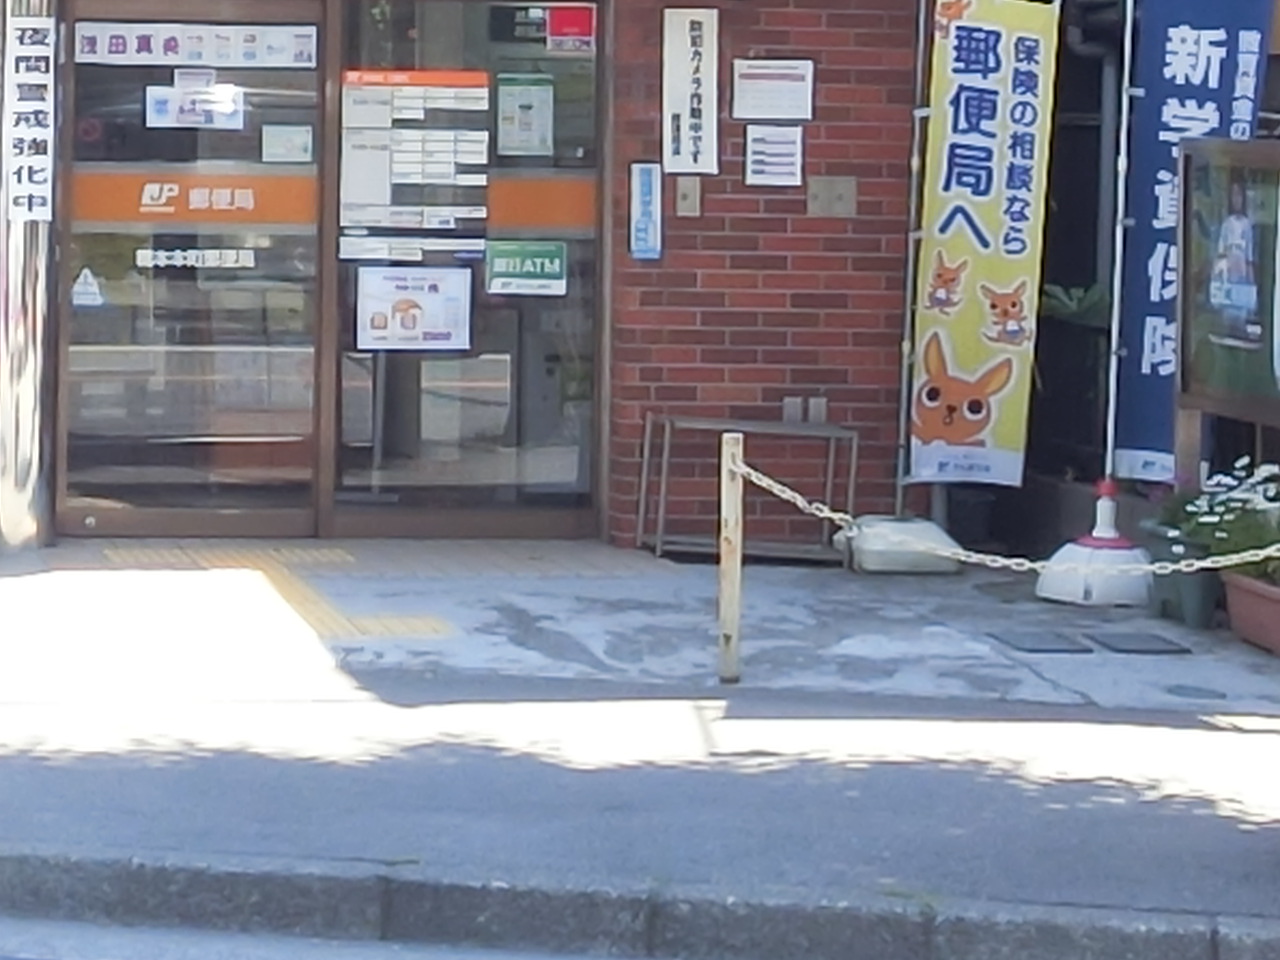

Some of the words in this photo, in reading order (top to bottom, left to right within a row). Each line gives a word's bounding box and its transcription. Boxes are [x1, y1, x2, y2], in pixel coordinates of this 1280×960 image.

[938, 24, 1003, 250] 郵便局へ
[1000, 36, 1041, 256] 保険の相談なら
